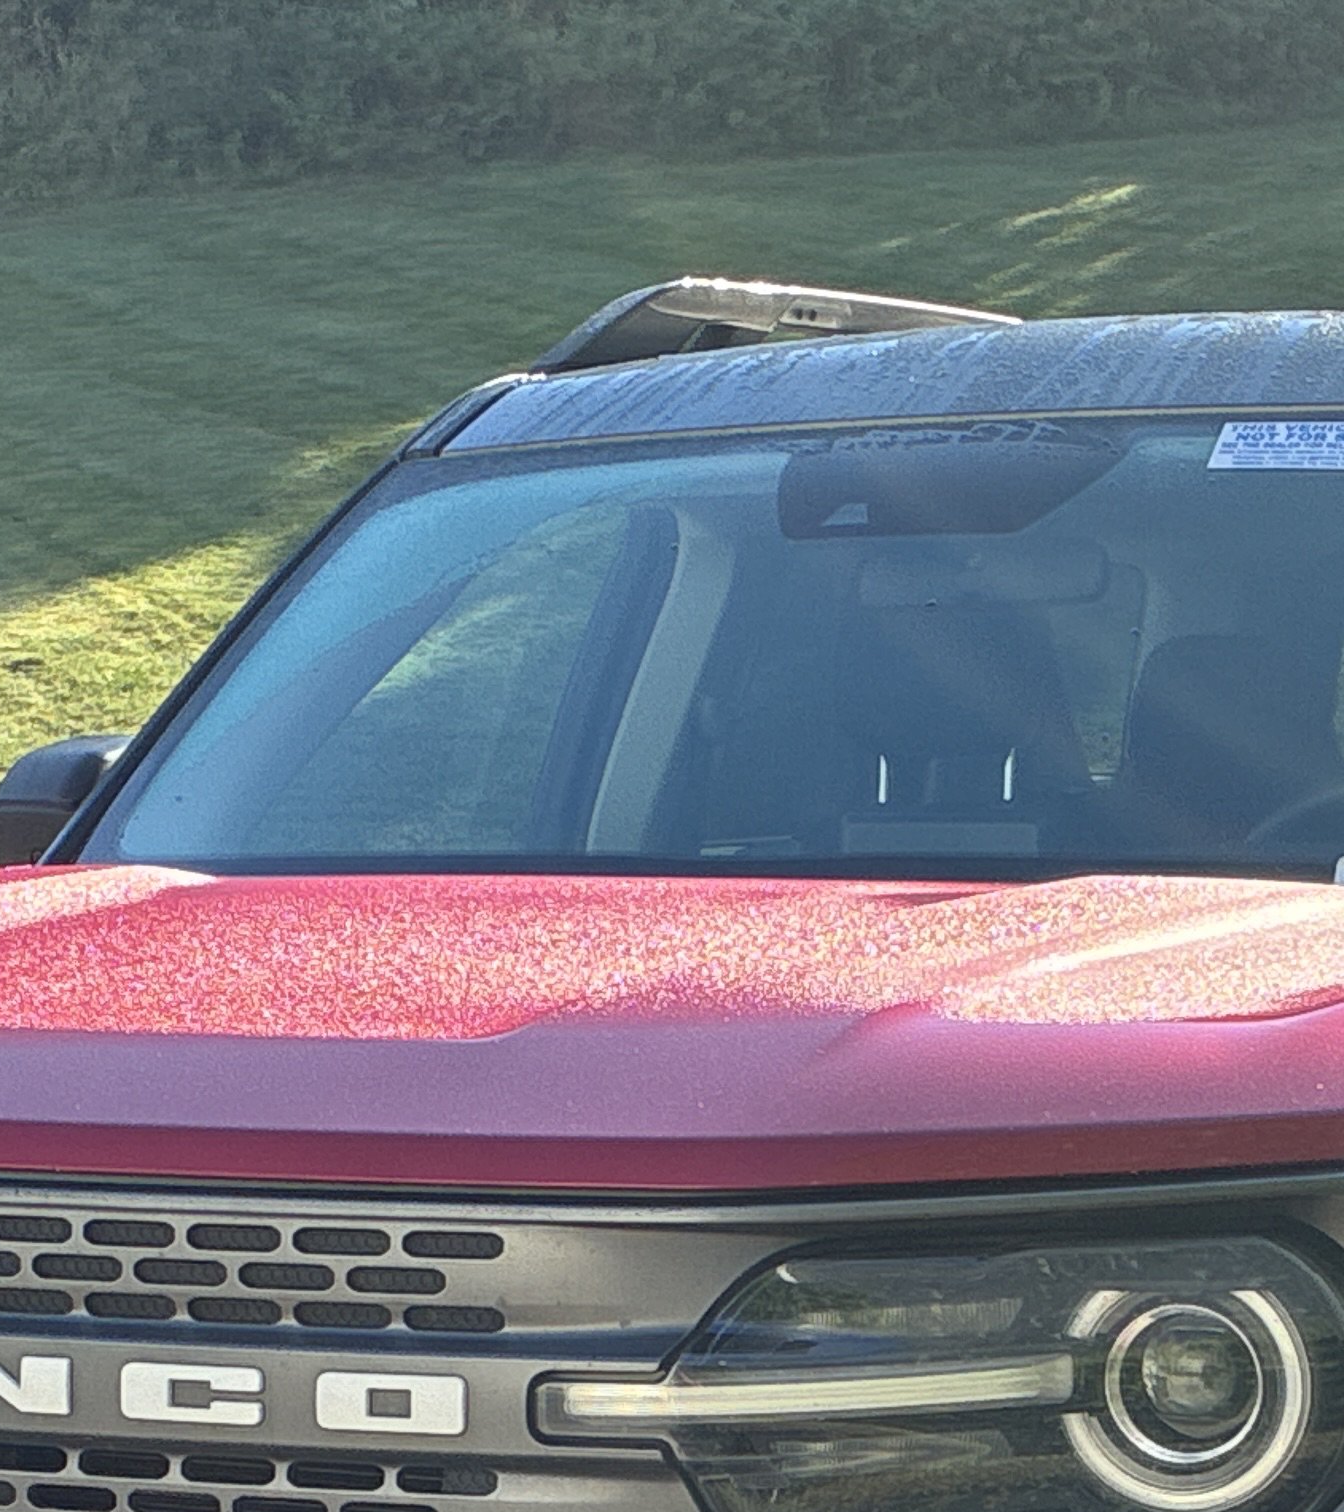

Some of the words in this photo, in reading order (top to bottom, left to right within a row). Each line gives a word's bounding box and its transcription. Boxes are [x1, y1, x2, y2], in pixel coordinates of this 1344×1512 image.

[1231, 424, 1277, 433] THIS
[1235, 432, 1280, 441] NOT
[1285, 432, 1327, 441] FOR
